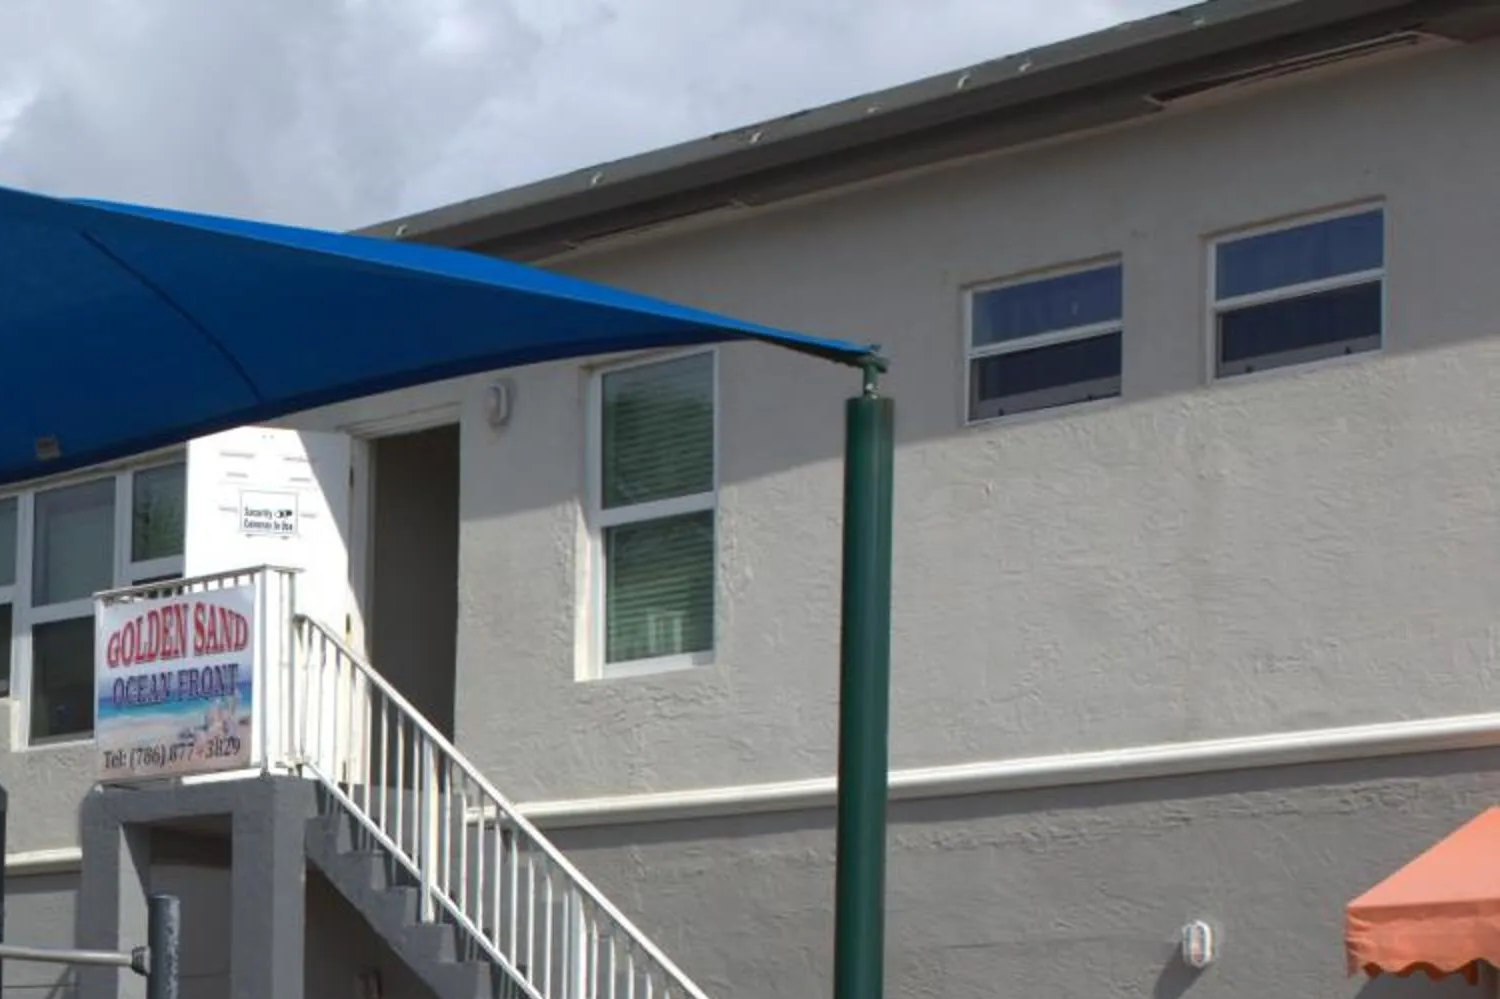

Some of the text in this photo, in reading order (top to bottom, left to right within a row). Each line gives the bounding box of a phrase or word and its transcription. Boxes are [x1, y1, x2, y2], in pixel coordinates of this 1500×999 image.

[107, 602, 249, 669] GOLDEN SAND
[112, 663, 239, 707] OCEAN FRONT
[103, 749, 127, 769] Tel:
